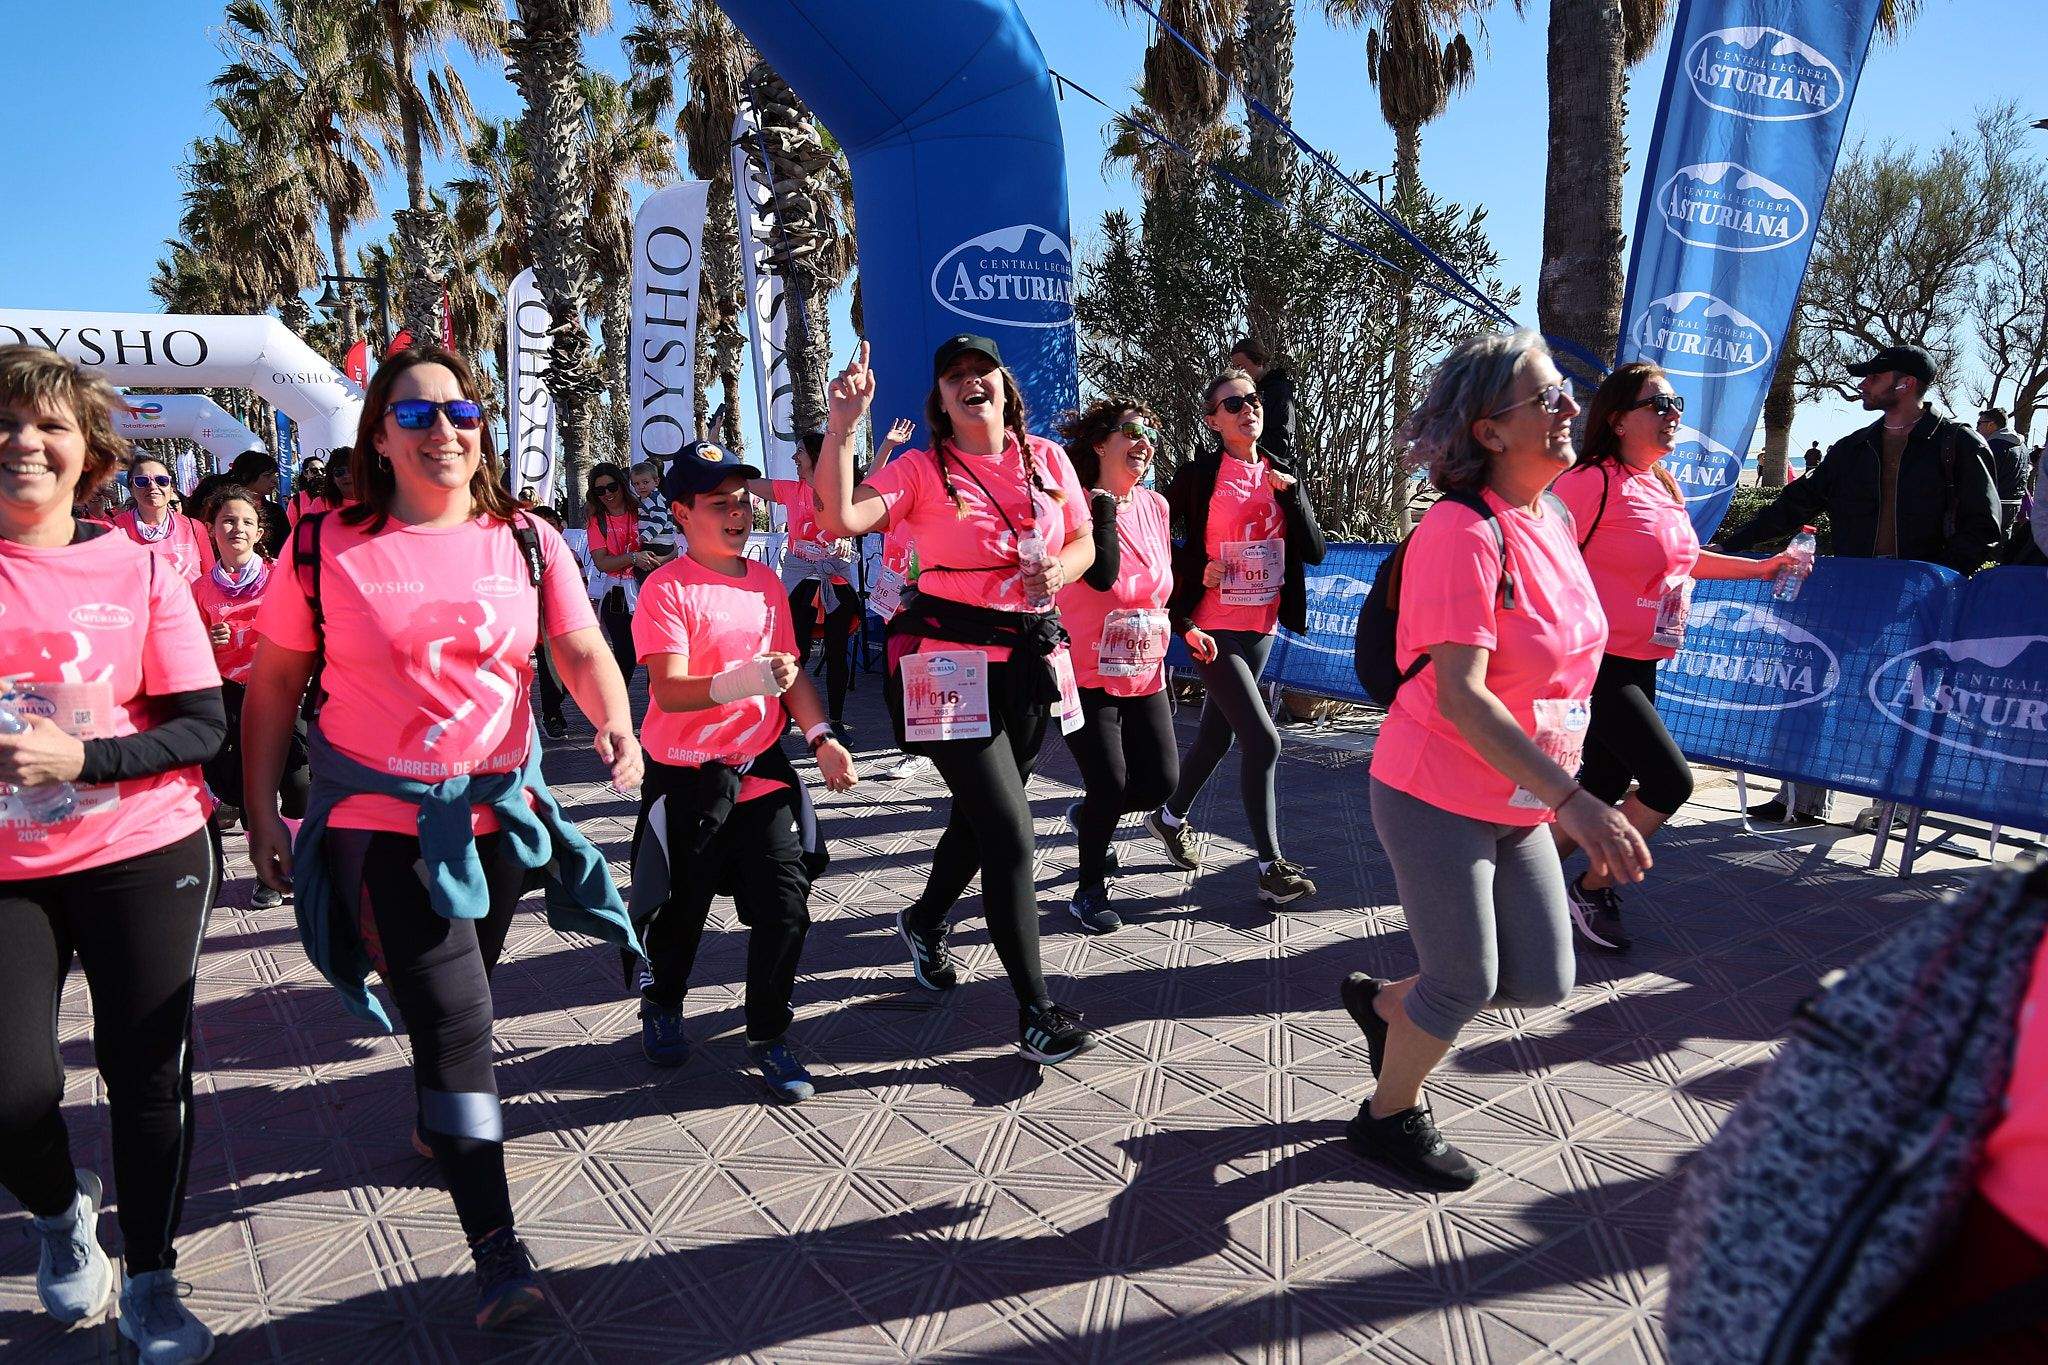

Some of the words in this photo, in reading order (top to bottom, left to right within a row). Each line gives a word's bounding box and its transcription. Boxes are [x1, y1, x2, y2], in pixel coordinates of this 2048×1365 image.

[1715, 50, 1767, 69] CENTRAL
[1771, 60, 1827, 81] LECHERA
[1693, 47, 1827, 108] ASTURIANA
[1684, 186, 1732, 201] CENTRAL
[1737, 194, 1790, 213] LECHERA
[1667, 184, 1789, 239] ASTURIANA
[979, 259, 1040, 270] CENTRAL
[640, 225, 693, 461] OYSHO
[1643, 314, 1755, 364] ASTURIANA
[272, 372, 332, 385] OYSHO
[1245, 569, 1269, 581] 016
[361, 580, 424, 595] OYSHO
[929, 690, 959, 706] 016
[667, 747, 711, 764] CARRERA
[387, 756, 449, 776] CARRERA
[453, 760, 471, 776] DE
[474, 760, 489, 772] LA
[18, 829, 49, 842] 2025
